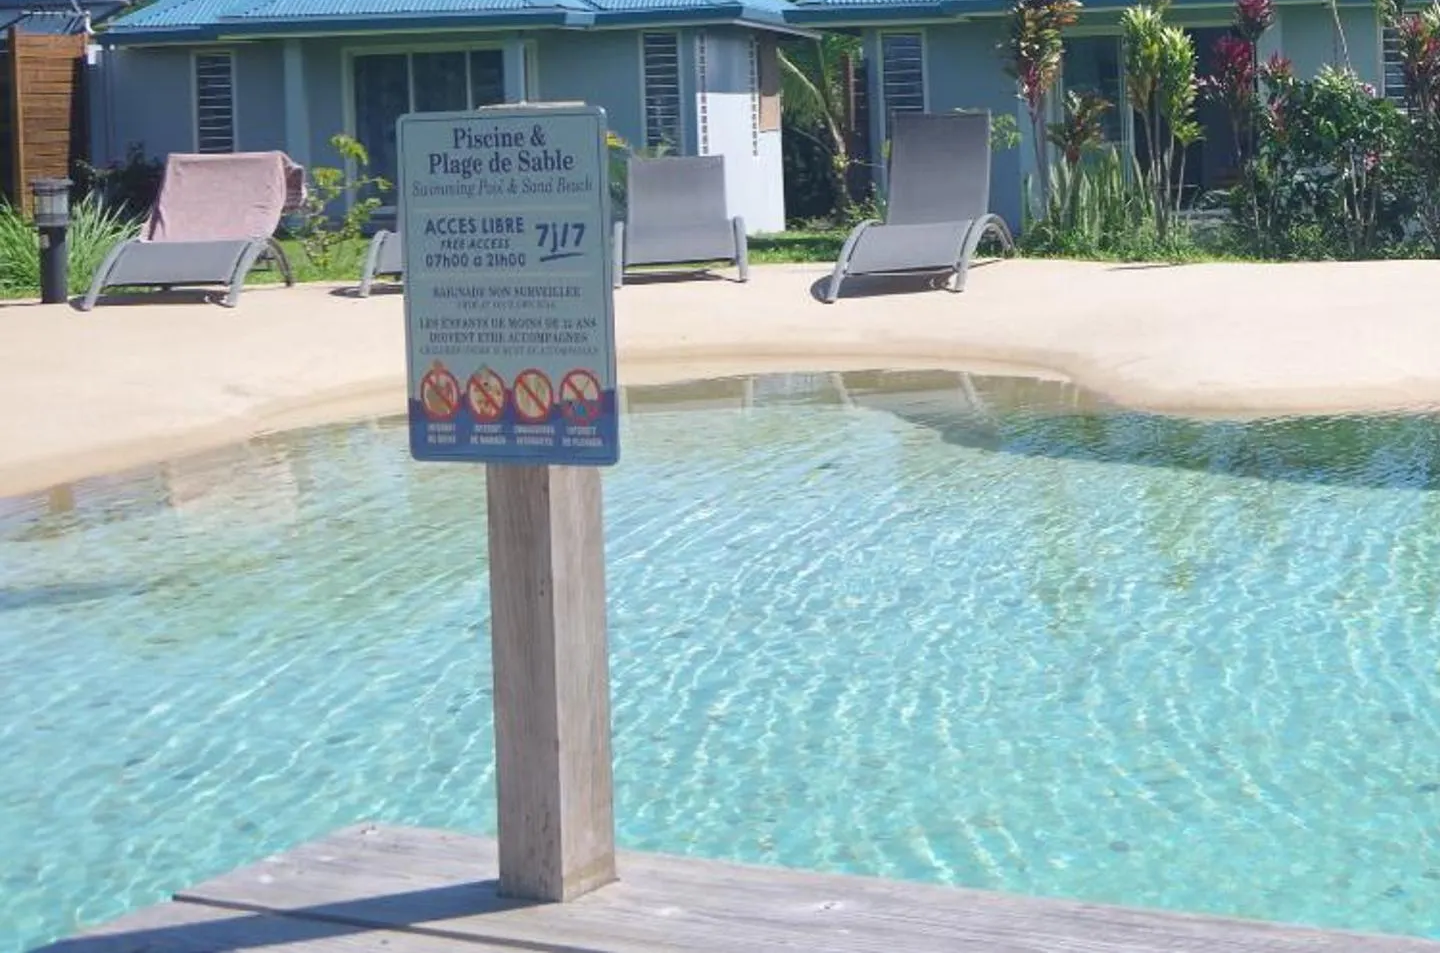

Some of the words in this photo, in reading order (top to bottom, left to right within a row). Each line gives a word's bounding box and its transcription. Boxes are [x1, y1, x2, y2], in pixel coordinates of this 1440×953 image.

[453, 126, 524, 149] Piscine
[530, 124, 546, 147] &
[429, 153, 482, 178] Plage
[489, 151, 512, 173] de
[518, 149, 574, 172] Sable
[425, 217, 477, 235] ACCES
[482, 217, 524, 234] LIBRE
[441, 238, 465, 250] FREE
[469, 238, 510, 249] ACCESS
[425, 253, 469, 268] 07h00
[487, 252, 527, 268] 21h00
